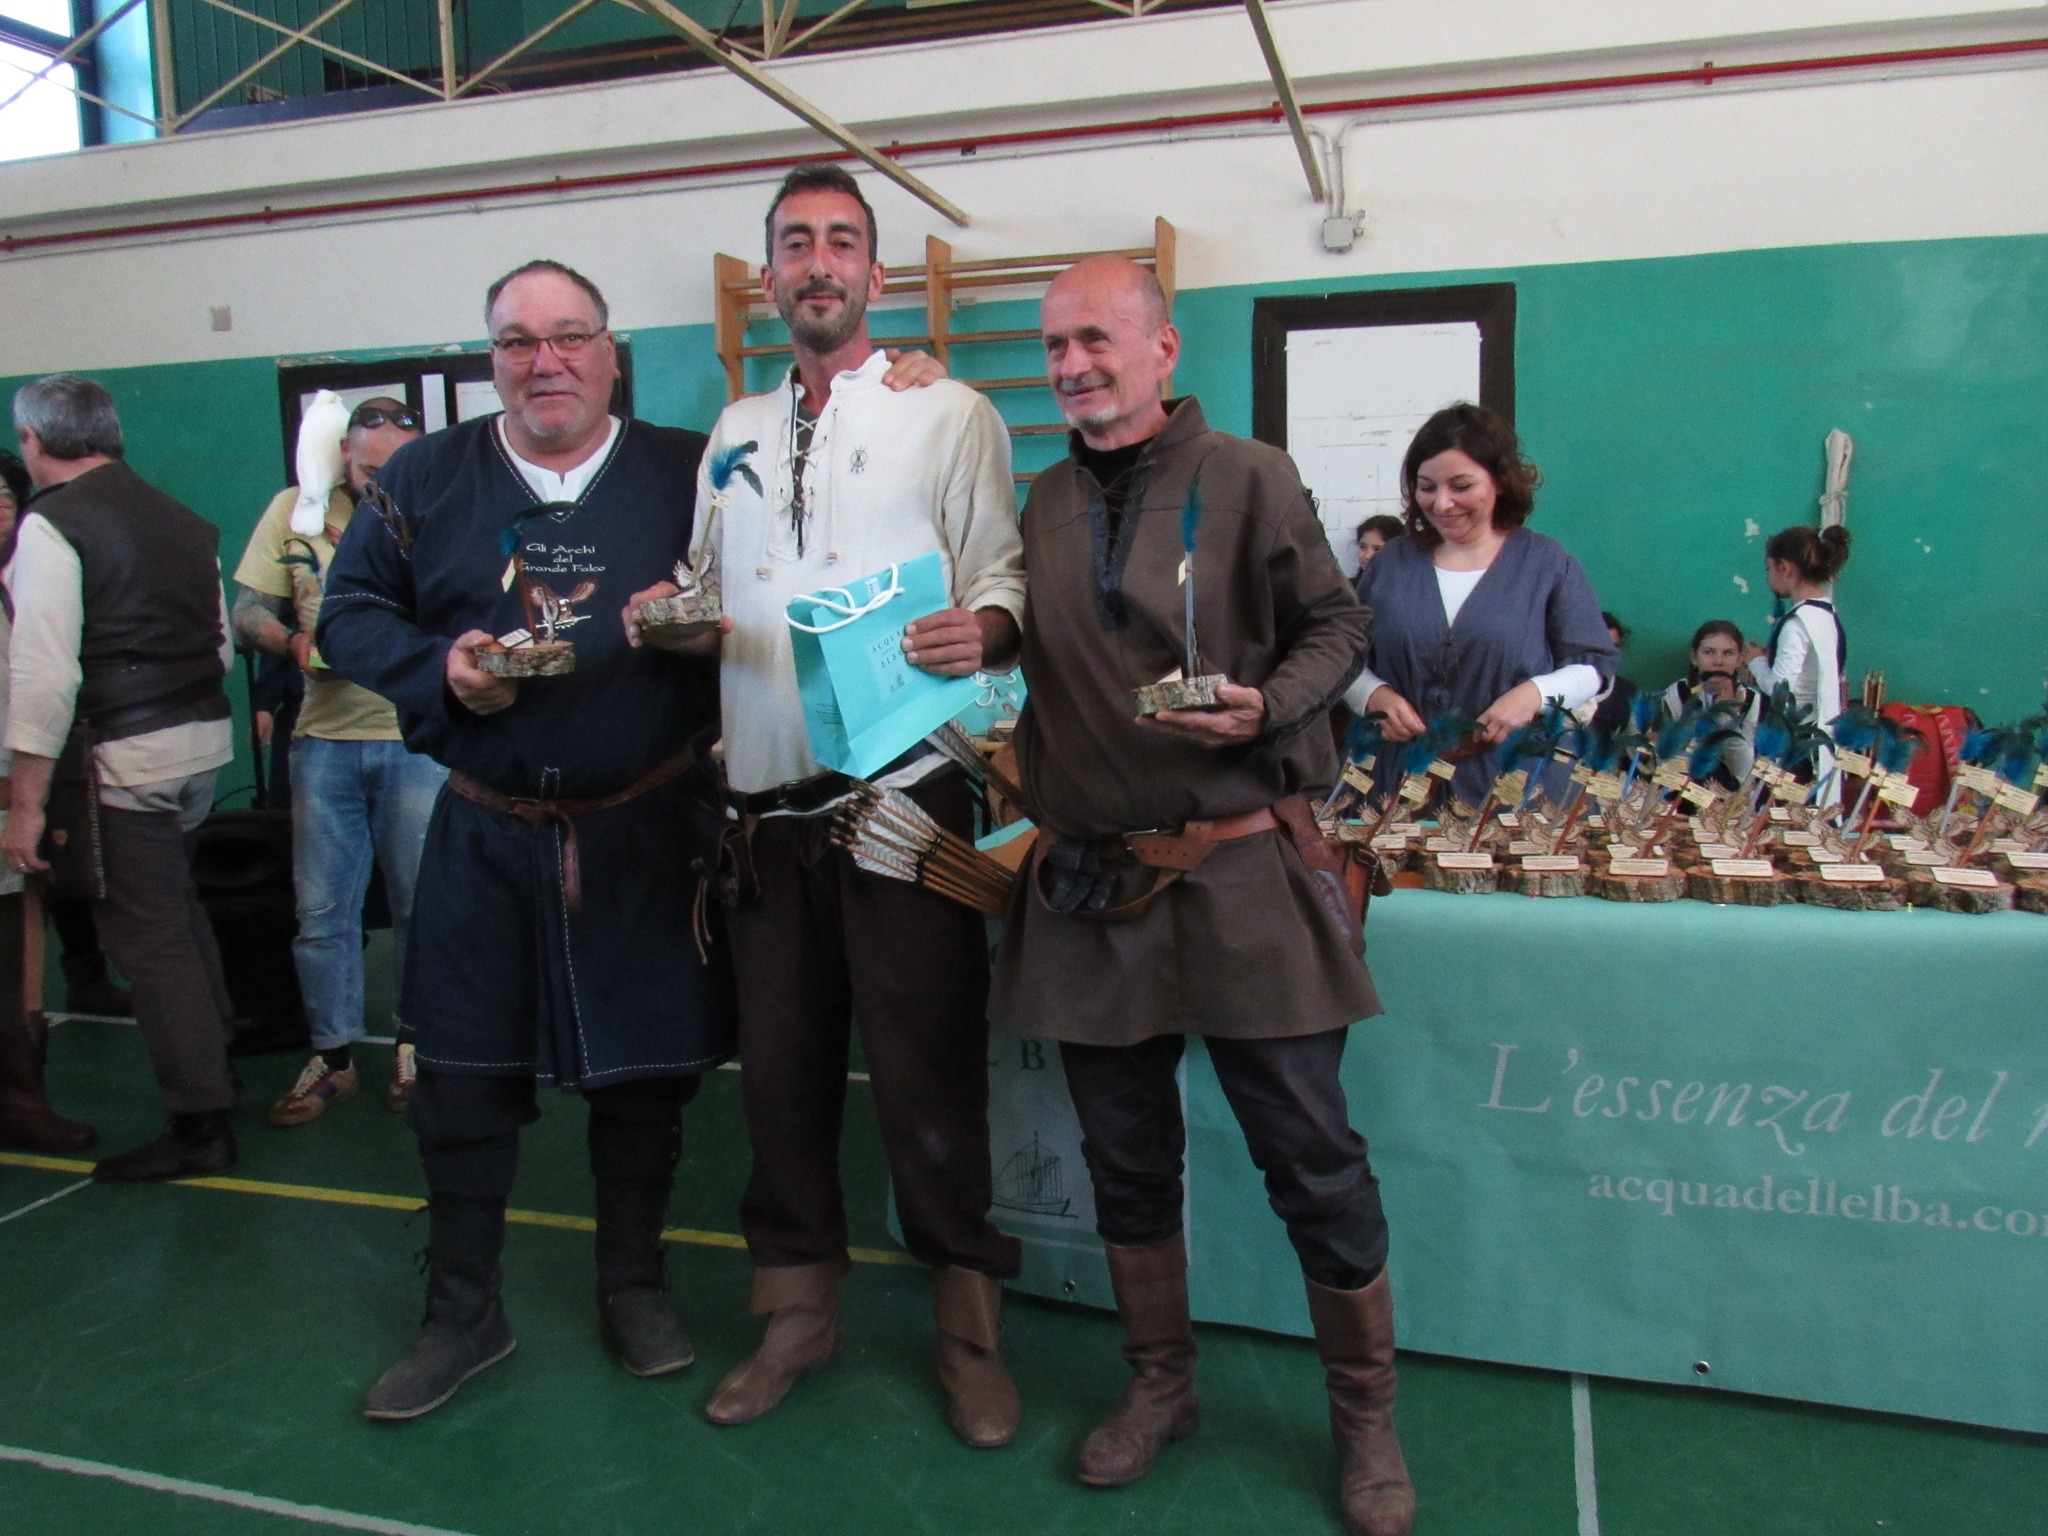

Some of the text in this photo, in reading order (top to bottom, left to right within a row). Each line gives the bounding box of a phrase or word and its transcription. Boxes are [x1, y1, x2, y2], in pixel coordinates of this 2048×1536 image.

[526, 543, 596, 554] Gli Archi
[553, 554, 573, 563] del
[872, 630, 901, 654] ACQUA
[1477, 1043, 1852, 1156] L'essenza
[1880, 1067, 2009, 1143] del
[1588, 1173, 2048, 1238] acquadellelba.co
